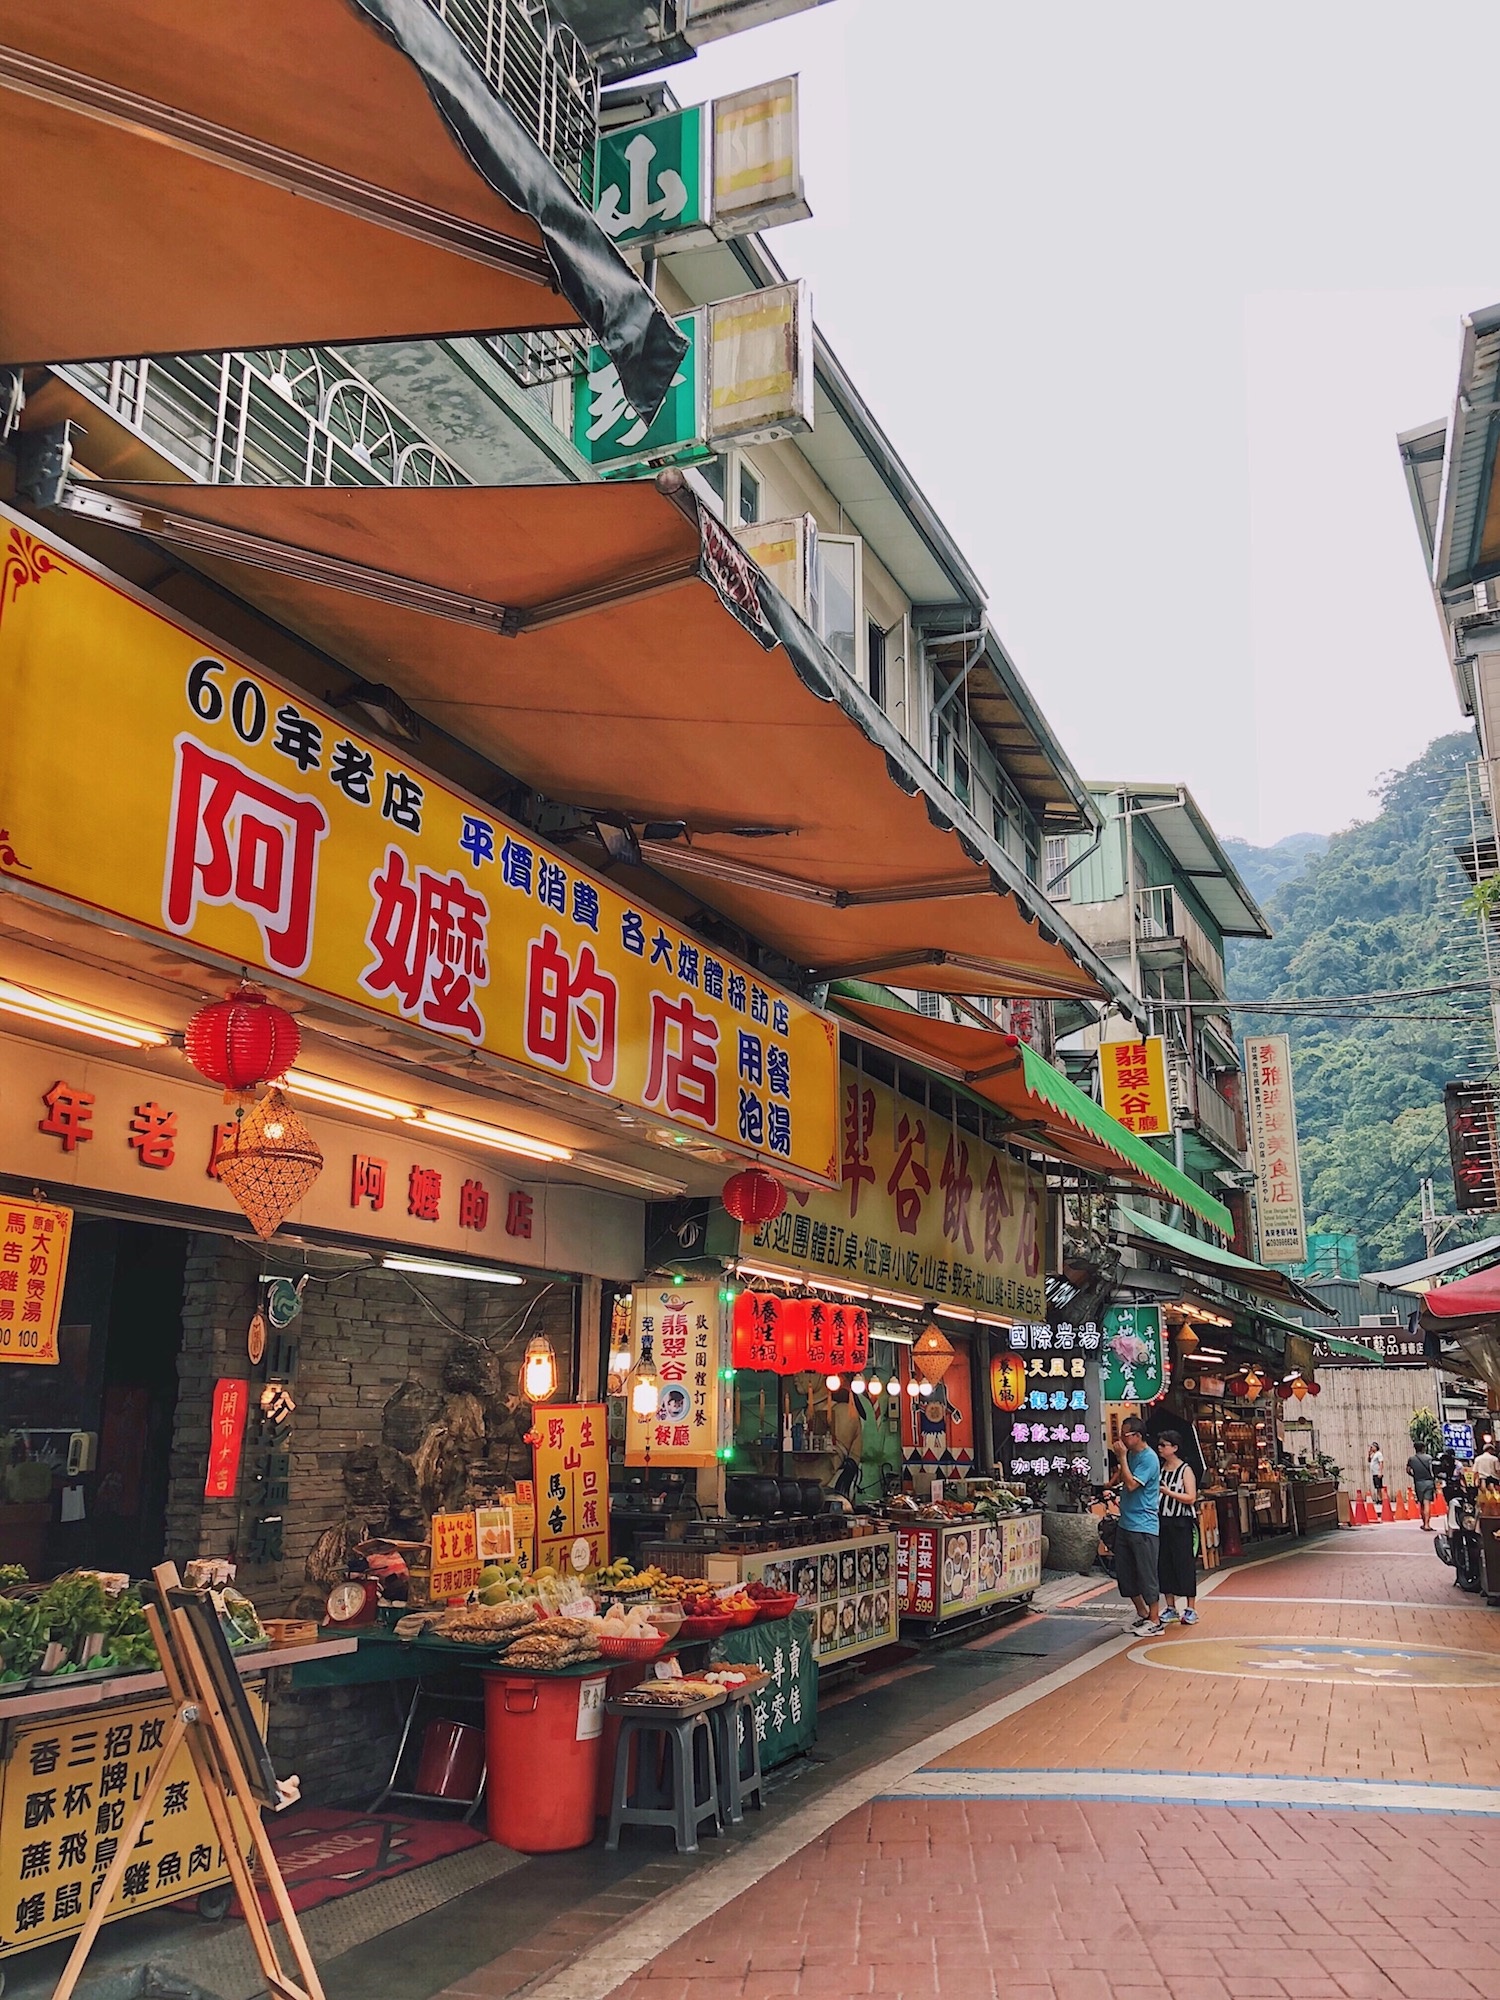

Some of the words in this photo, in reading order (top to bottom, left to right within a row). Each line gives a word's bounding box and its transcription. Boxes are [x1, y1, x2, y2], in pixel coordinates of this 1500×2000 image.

[187, 658, 425, 834] 60年老店
[459, 814, 601, 934] 平價消費
[619, 909, 791, 1038] 各大媒體採訪店
[165, 737, 721, 1130] 阿嬤的店
[737, 1028, 791, 1101] 用餐
[1115, 1044, 1151, 1115] 翡翠谷
[738, 1087, 791, 1157] 泡湯
[351, 1153, 535, 1241] 阿嬤的店
[18, 1329, 39, 1349] 100
[659, 1313, 689, 1383] 翡翠谷
[1009, 1321, 1100, 1351] 國際岩湯
[1023, 1358, 1086, 1378] 天風呂
[1018, 1390, 1089, 1411] 觀湯屋
[214, 1391, 240, 1491] 開市大吉
[548, 1416, 595, 1449] 野生
[563, 1447, 582, 1470] 山
[655, 1423, 690, 1446] 餐廳
[1011, 1422, 1090, 1443] 餐飲冰品
[1010, 1455, 1092, 1477] 咖啡午茶
[547, 1472, 568, 1534] 馬告
[582, 1471, 600, 1530] 旦蕉
[917, 1532, 934, 1599] 五菜一湯
[914, 1600, 934, 1614] 599
[52, 1731, 98, 1922] 三杯飛鼠
